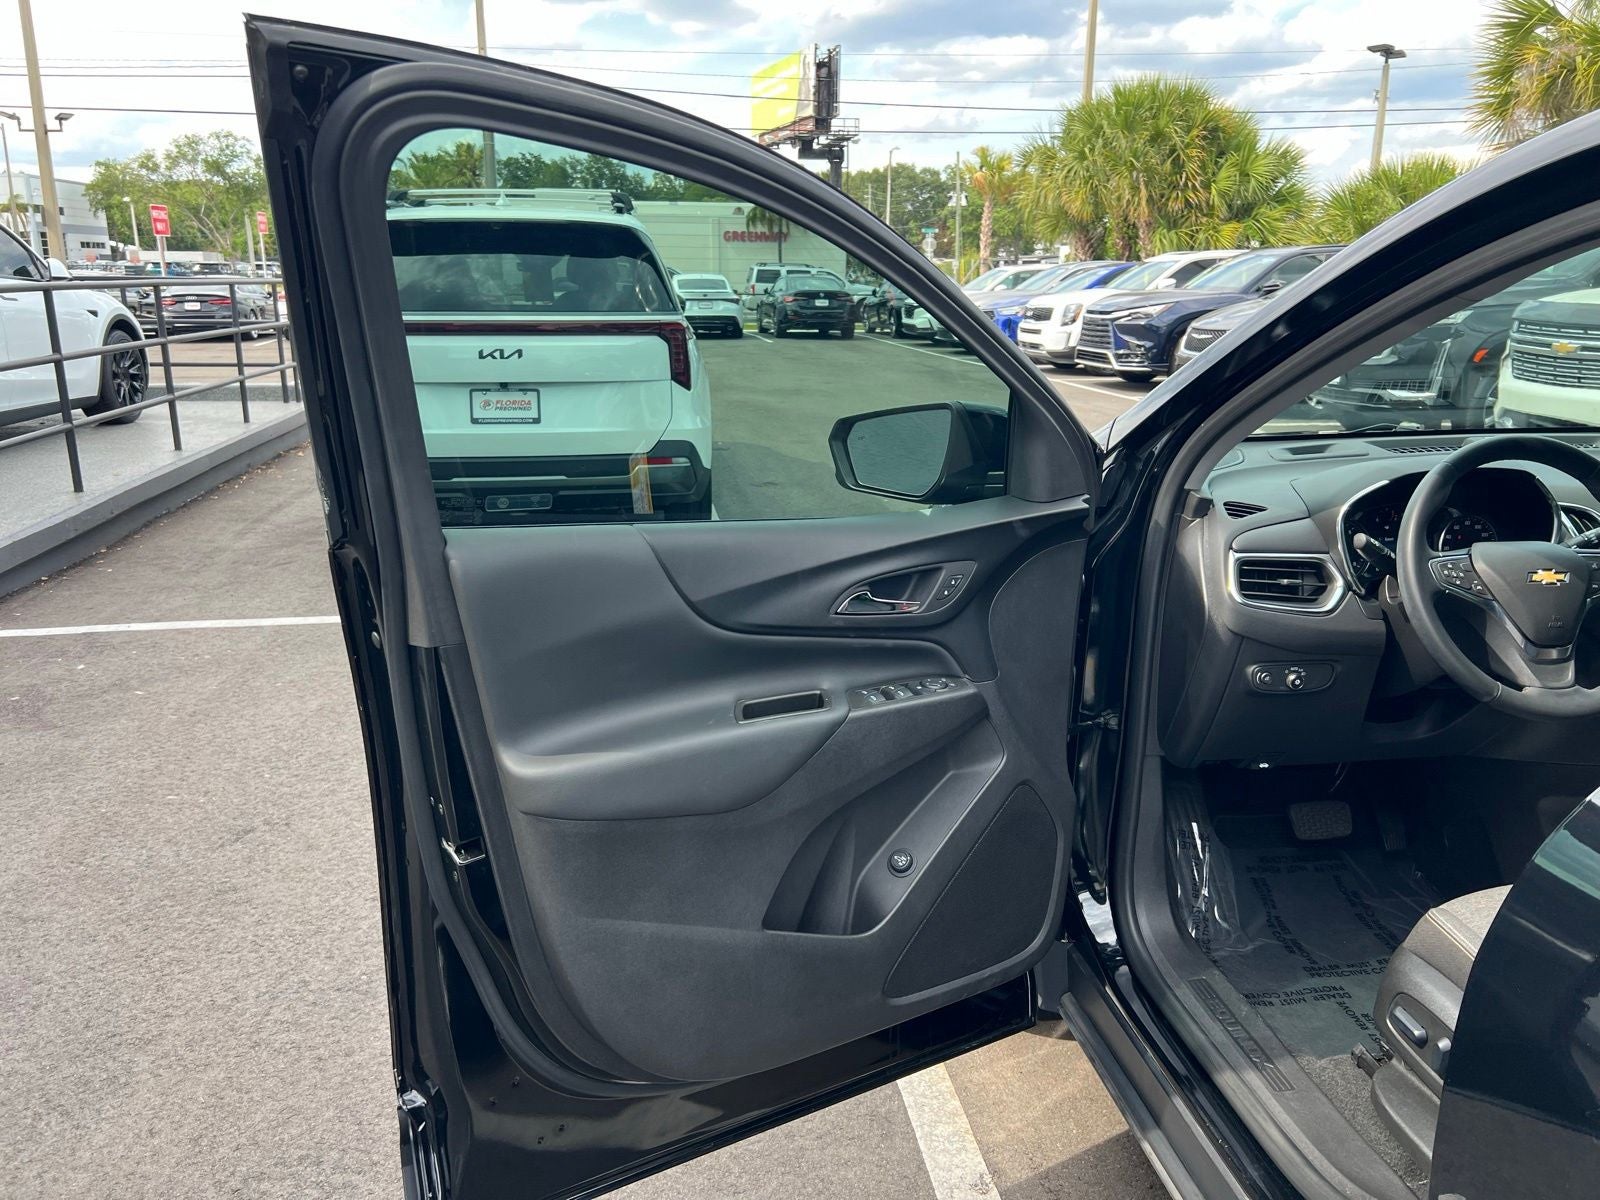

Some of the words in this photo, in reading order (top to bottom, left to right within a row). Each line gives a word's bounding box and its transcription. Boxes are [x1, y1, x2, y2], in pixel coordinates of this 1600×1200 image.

[478, 348, 523, 360] KIA
[495, 399, 532, 407] FLORIDA
[1279, 997, 1307, 1006] MUST
